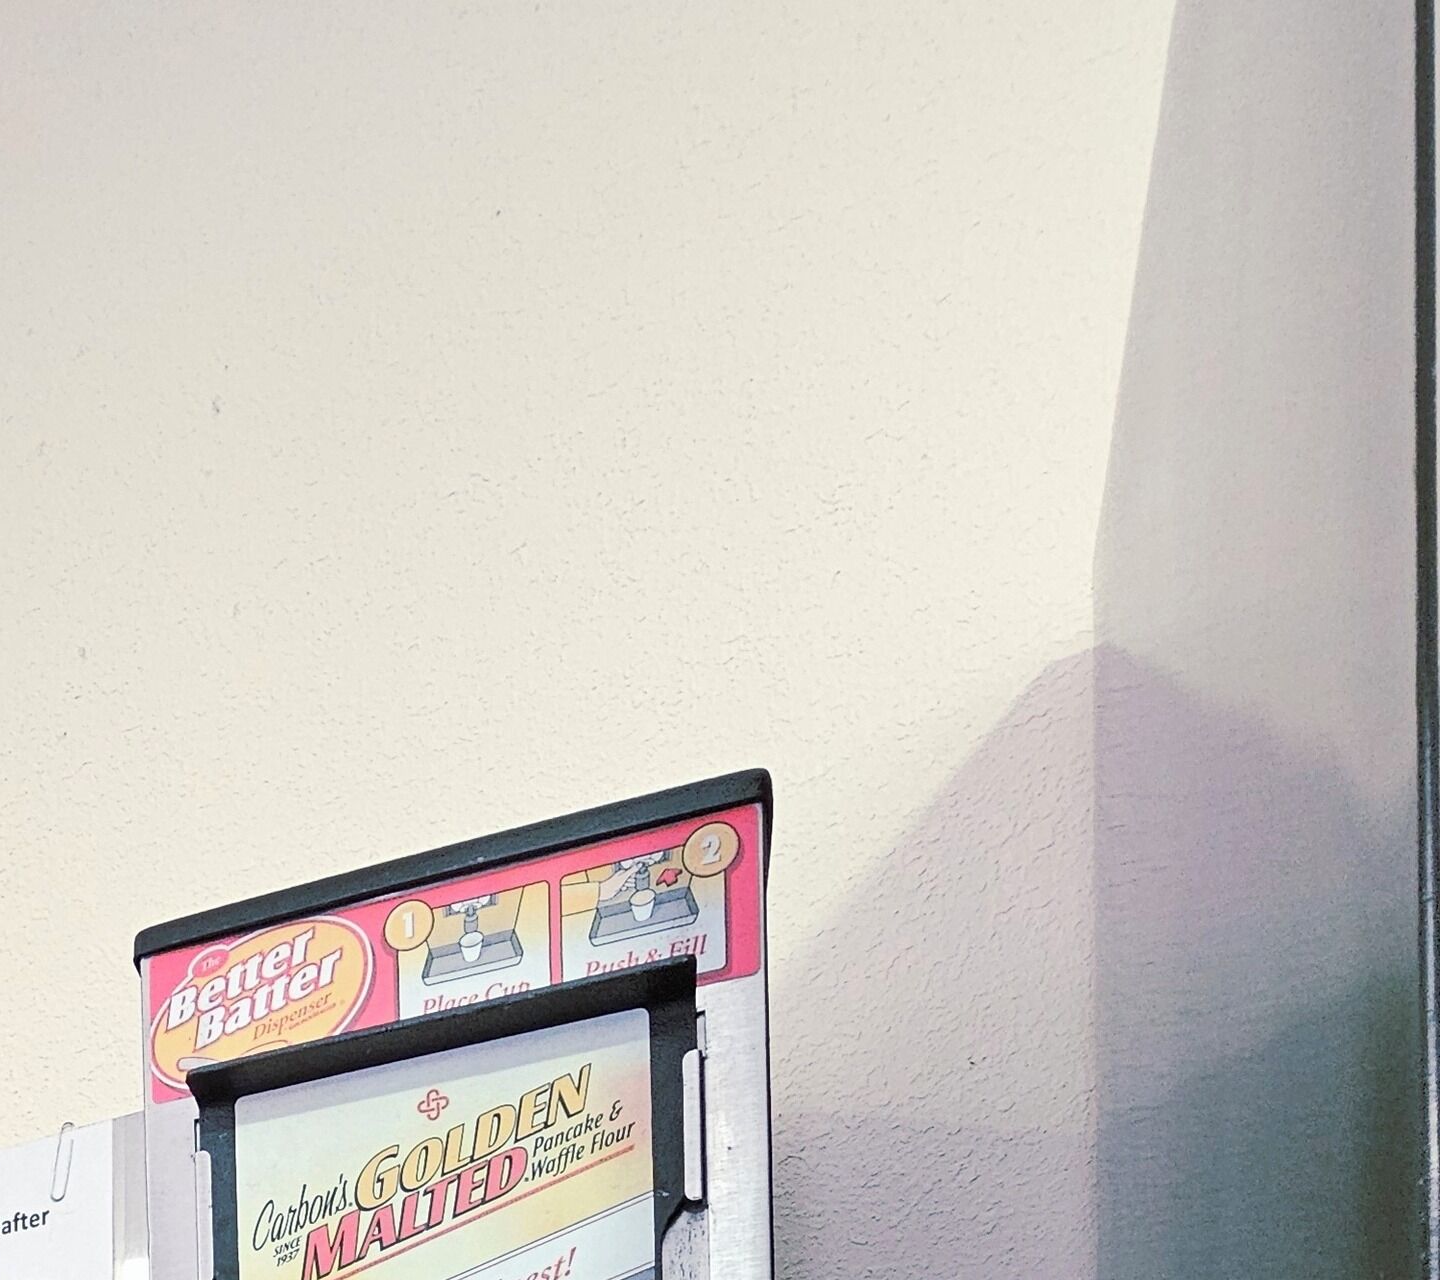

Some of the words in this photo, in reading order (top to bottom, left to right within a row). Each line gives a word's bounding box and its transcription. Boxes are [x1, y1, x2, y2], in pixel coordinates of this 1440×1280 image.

[700, 835, 722, 865] 2
[404, 911, 415, 938] 1
[165, 926, 316, 1034] Better
[193, 947, 343, 1054] Batter
[253, 991, 333, 1040] Dispenser
[531, 1143, 585, 1181] Waffle
[591, 1121, 636, 1154] Flour
[532, 1113, 604, 1157] Pancake
[609, 1099, 623, 1122] &
[252, 1173, 348, 1251] Carbon's
[354, 1063, 592, 1211] GOLDEN
[1, 1210, 50, 1235] after
[273, 1236, 302, 1257] SINCE
[276, 1248, 300, 1267] 1937
